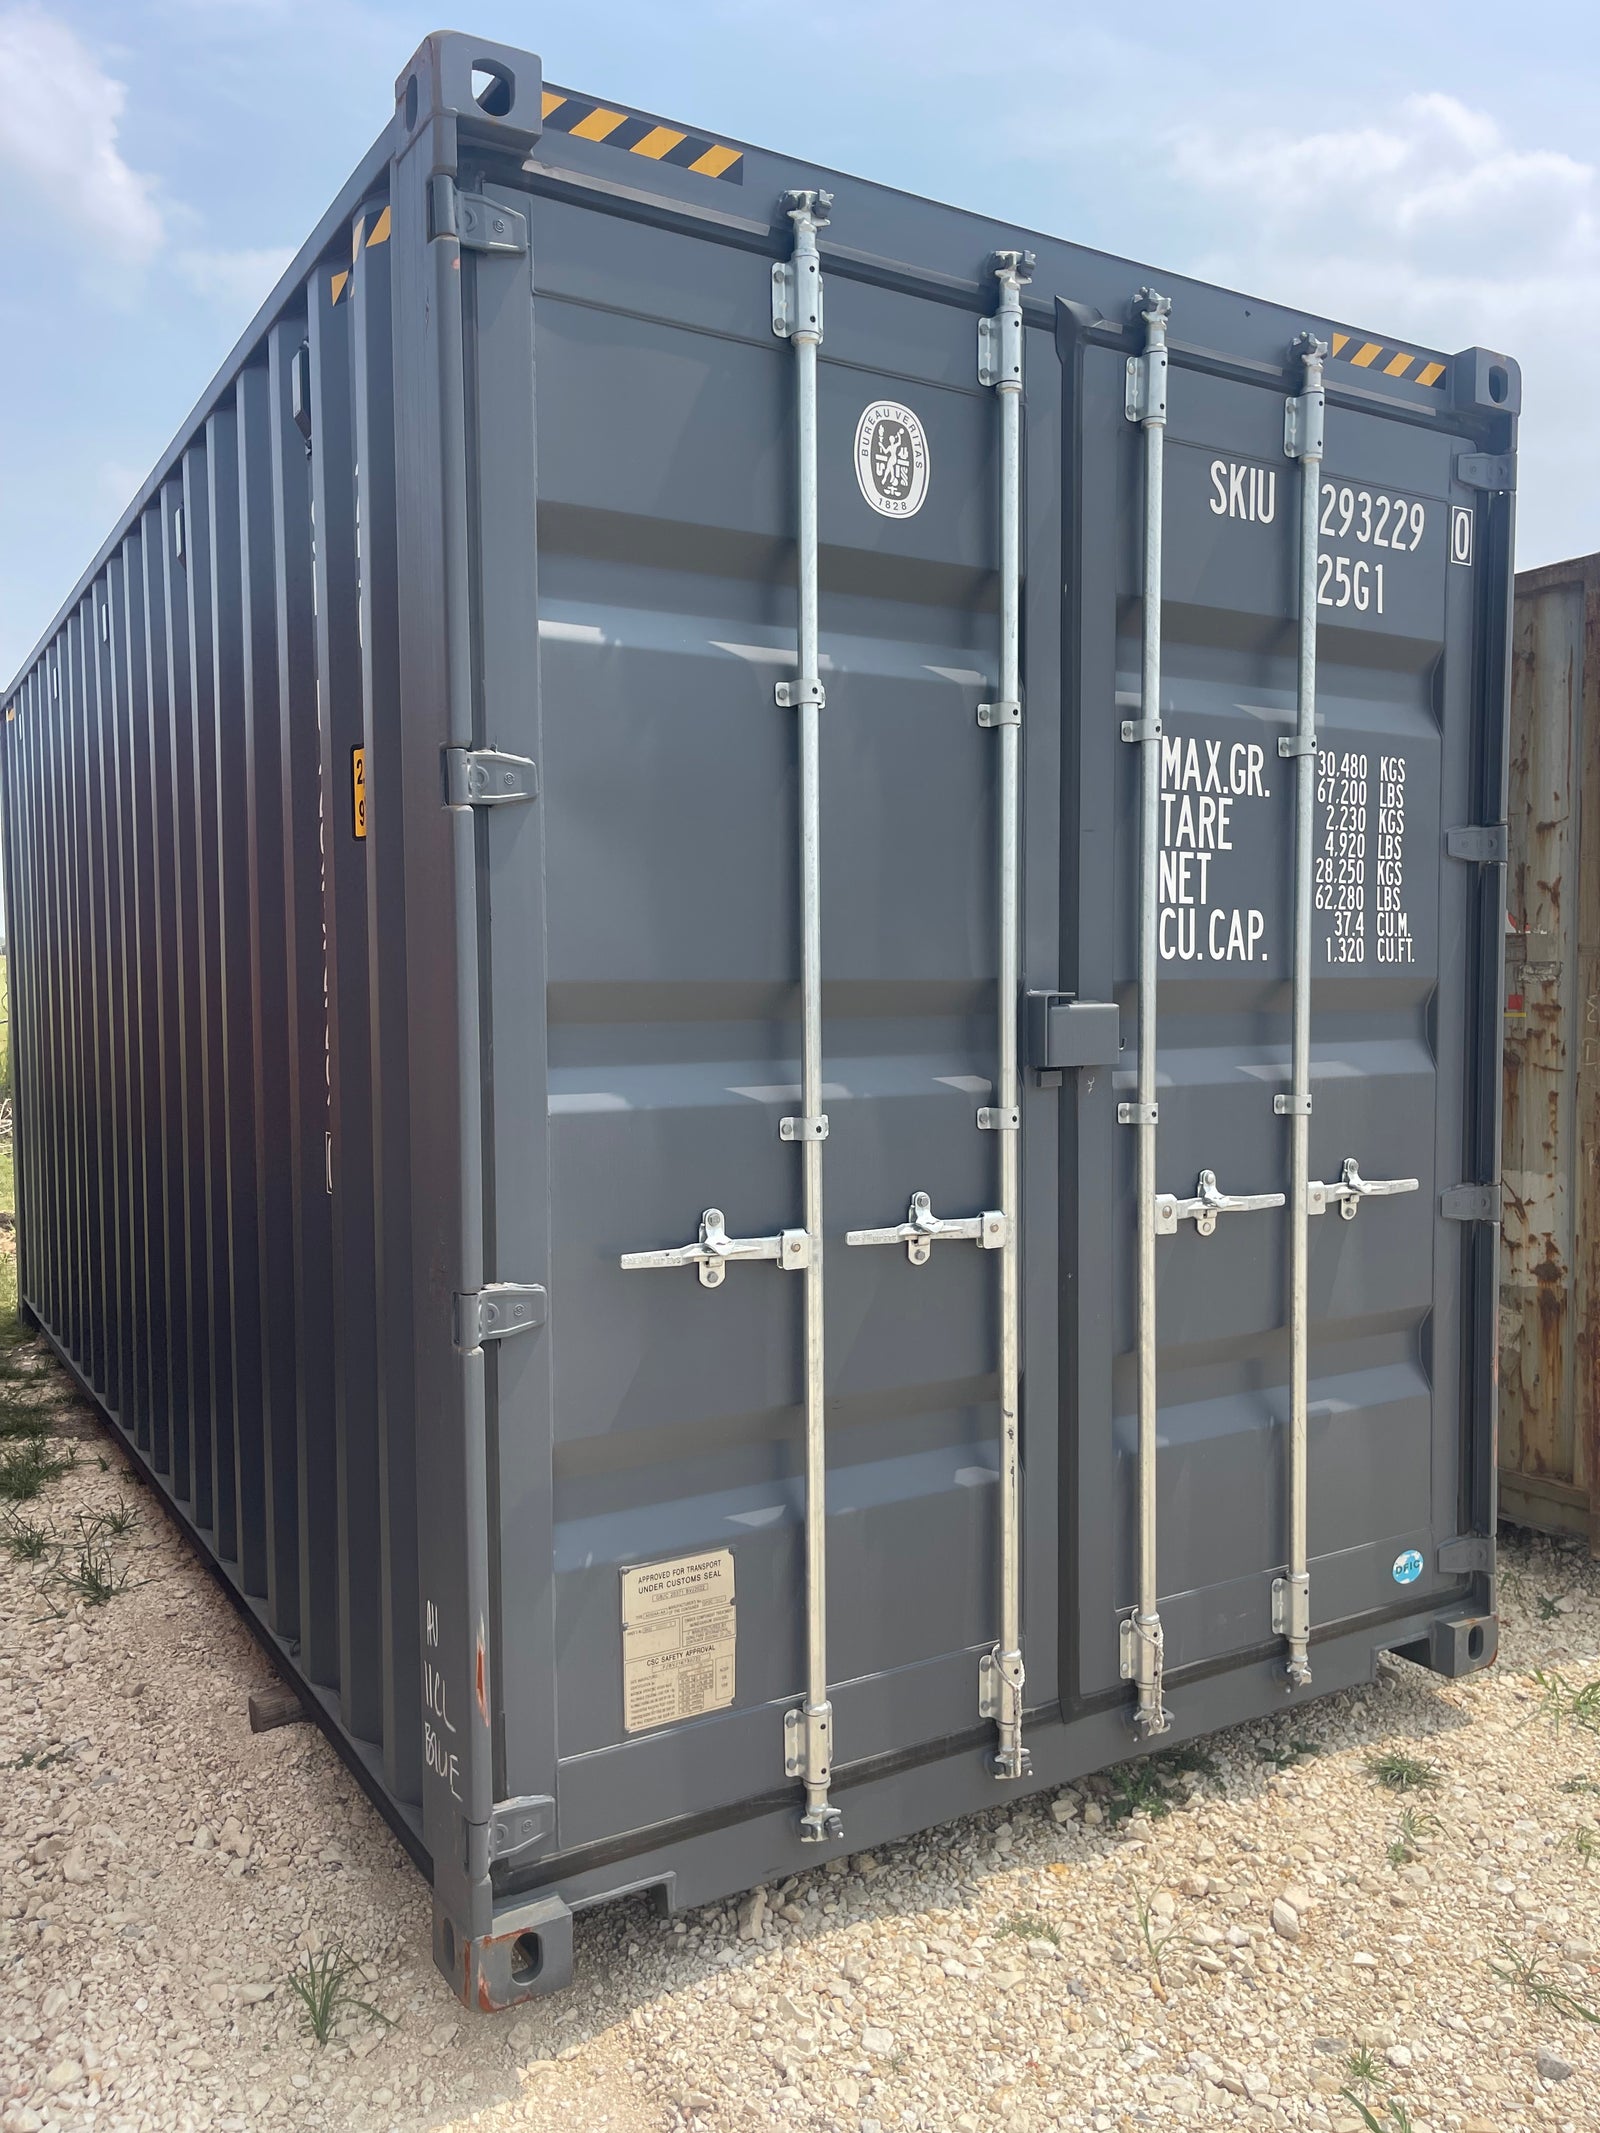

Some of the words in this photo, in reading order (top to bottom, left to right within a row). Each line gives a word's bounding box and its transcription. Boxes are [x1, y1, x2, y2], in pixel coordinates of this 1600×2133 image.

[861, 408, 890, 457] BUREAU
[895, 410, 923, 469] VERITAS
[878, 497, 907, 511] 1828
[1209, 460, 1275, 524] SKIU
[1319, 483, 1425, 551] 293229
[1453, 510, 1470, 561] 0
[1317, 553, 1383, 614] 25G1
[1161, 735, 1271, 797] MAX.GR.
[1317, 750, 1367, 779] 30,480
[1380, 756, 1405, 783] KGS
[1317, 778, 1367, 805] 67,200
[1380, 782, 1404, 809] LBS
[1160, 793, 1233, 850] TARE
[1325, 805, 1366, 832] 2,230
[1379, 808, 1404, 835] KGS
[1325, 831, 1366, 858] 4,920
[1377, 834, 1402, 860] LBS
[1159, 850, 1212, 905] NET
[1316, 858, 1364, 885] 28,250
[1377, 860, 1402, 886] KGS
[1315, 884, 1364, 911] 62,280
[1376, 886, 1401, 912] LBS
[1334, 911, 1365, 937] 37.4
[1377, 912, 1411, 938] CU.M.
[1326, 937, 1365, 963] 1,320
[1377, 937, 1415, 963] CU.FT.
[638, 1570, 671, 1585] APPROVED
[672, 1567, 685, 1577] FOR
[686, 1559, 722, 1575] TRANSPORT
[638, 1582, 664, 1595] UNDER
[666, 1575, 702, 1588] CUSTOMS
[703, 1570, 722, 1580] SEAL
[646, 1658, 660, 1667] CSC
[661, 1652, 684, 1664] SAFETY
[685, 1644, 717, 1657] APPROVAL
